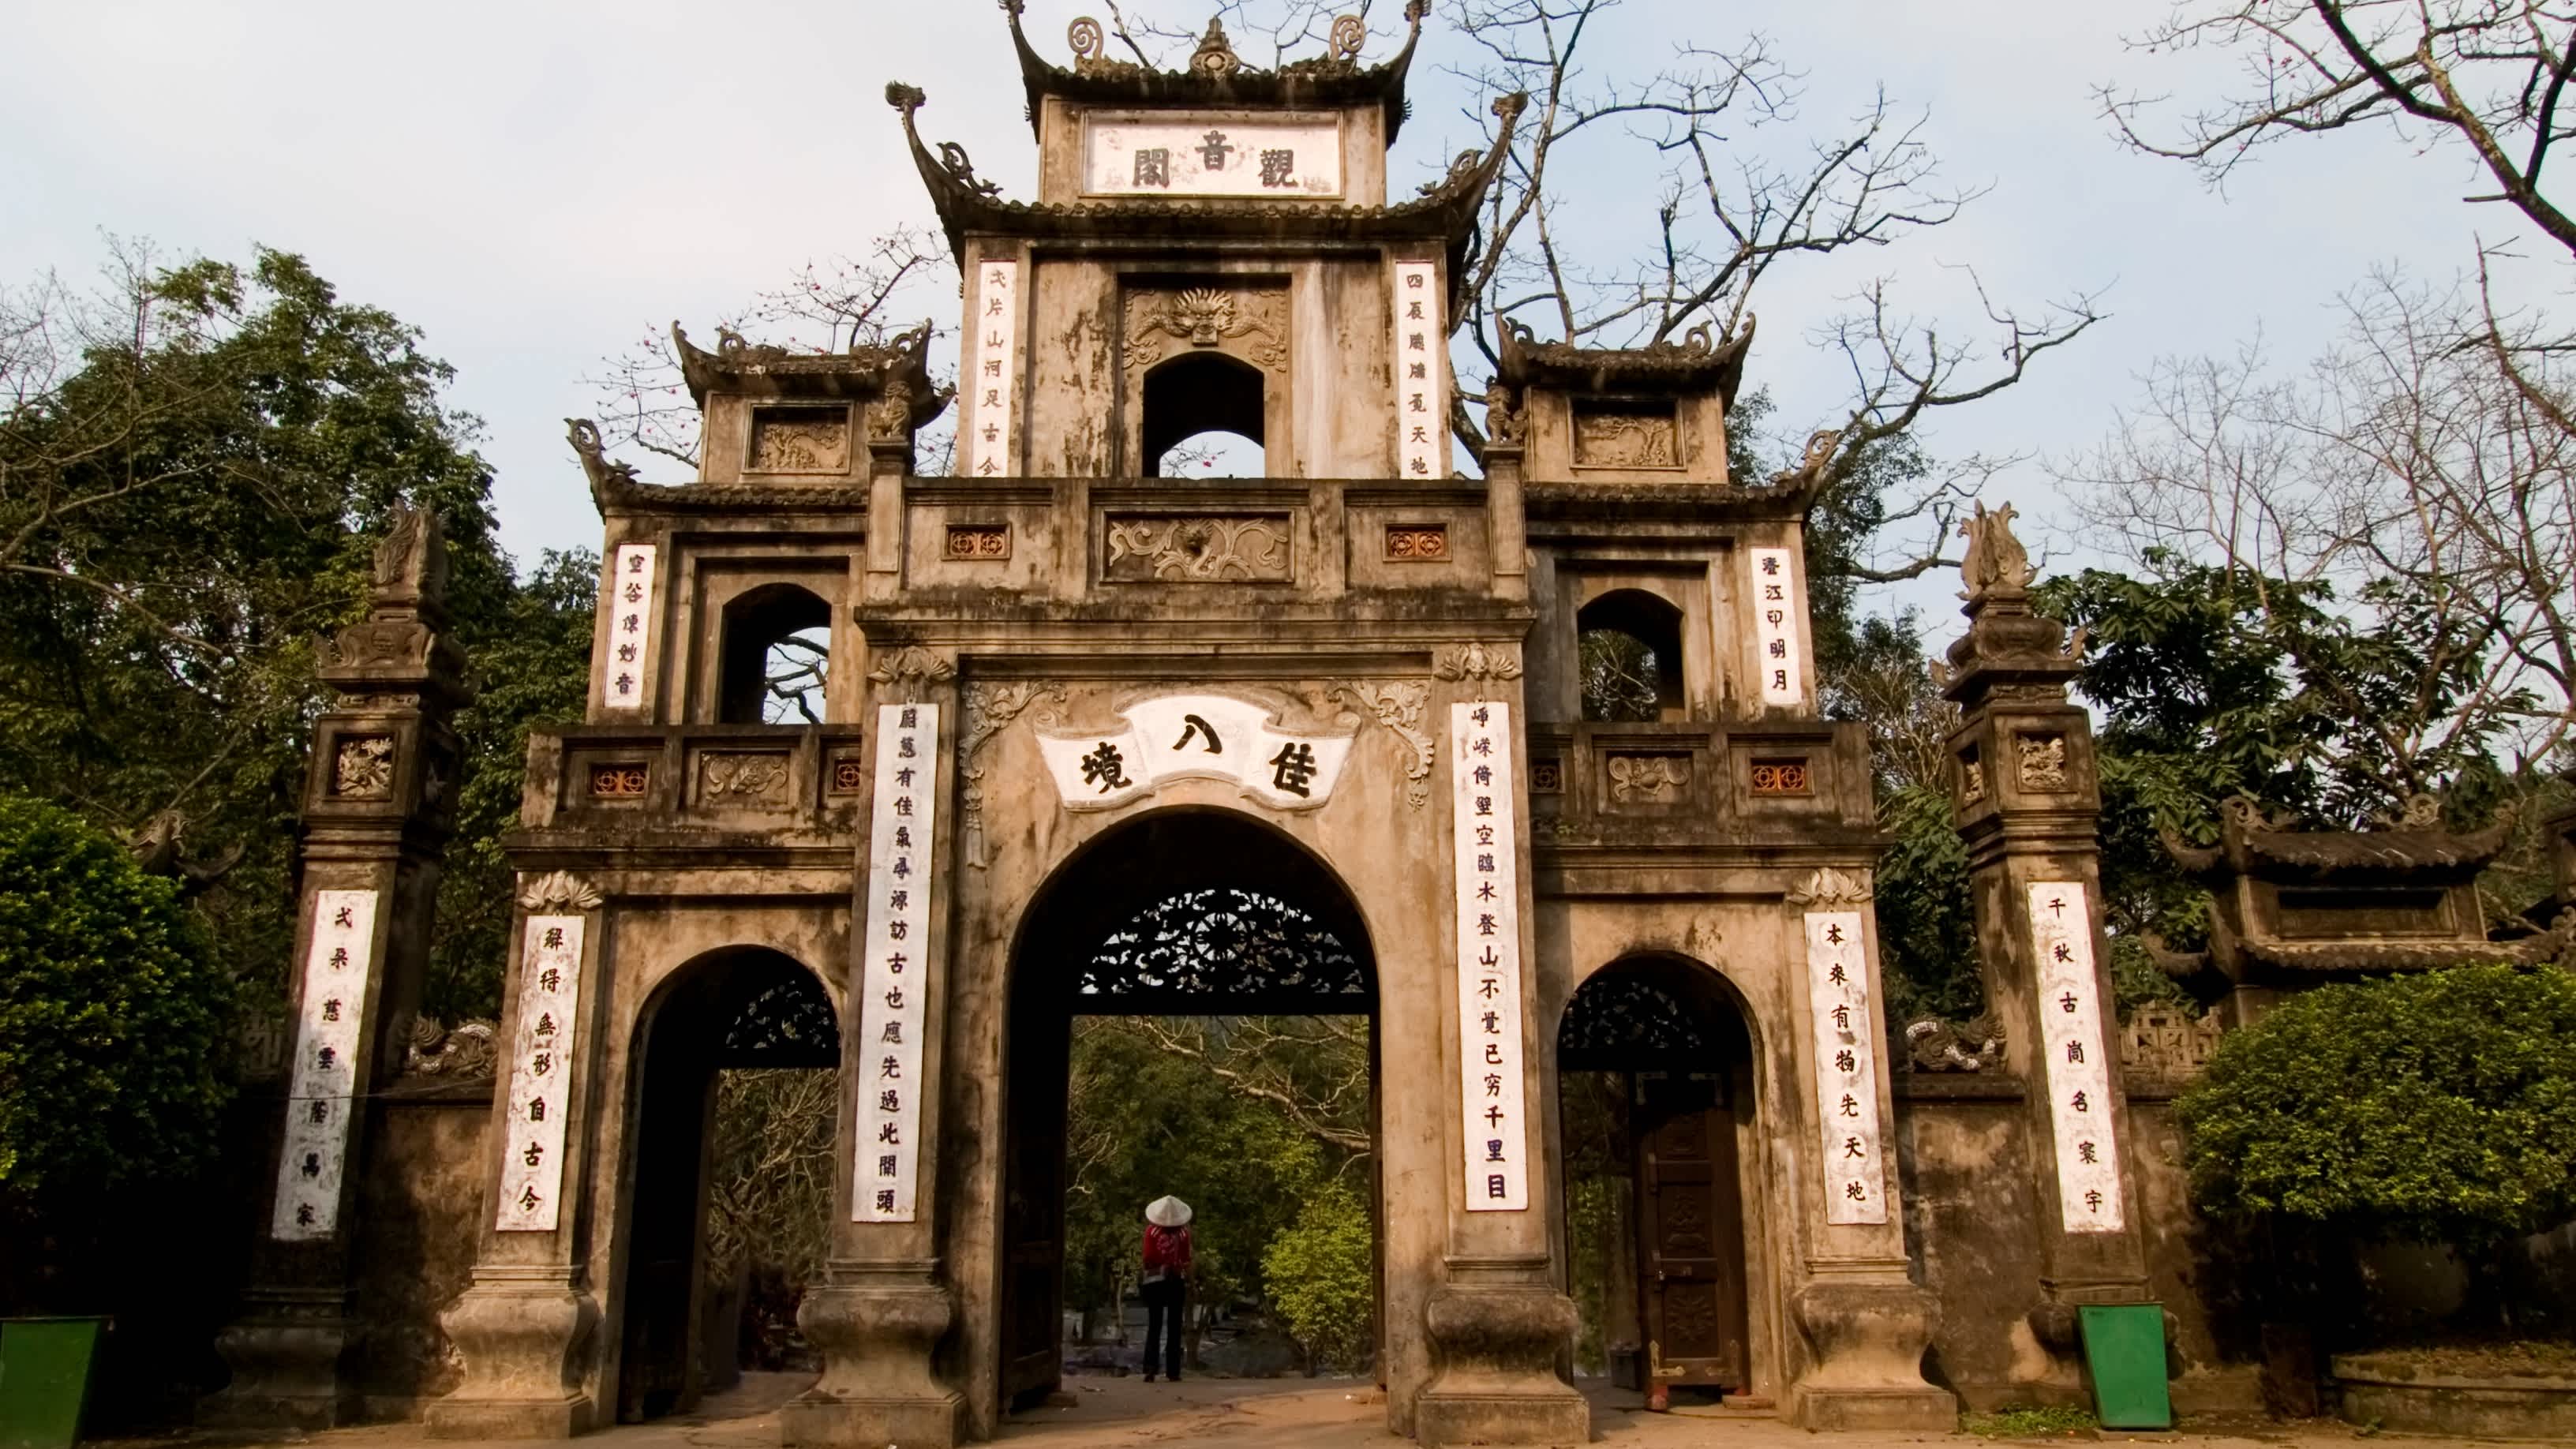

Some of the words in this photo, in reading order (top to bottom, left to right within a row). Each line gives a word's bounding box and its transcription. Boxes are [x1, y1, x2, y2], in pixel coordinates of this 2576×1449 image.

[1825, 923, 1866, 1202] 本來有物先天地
